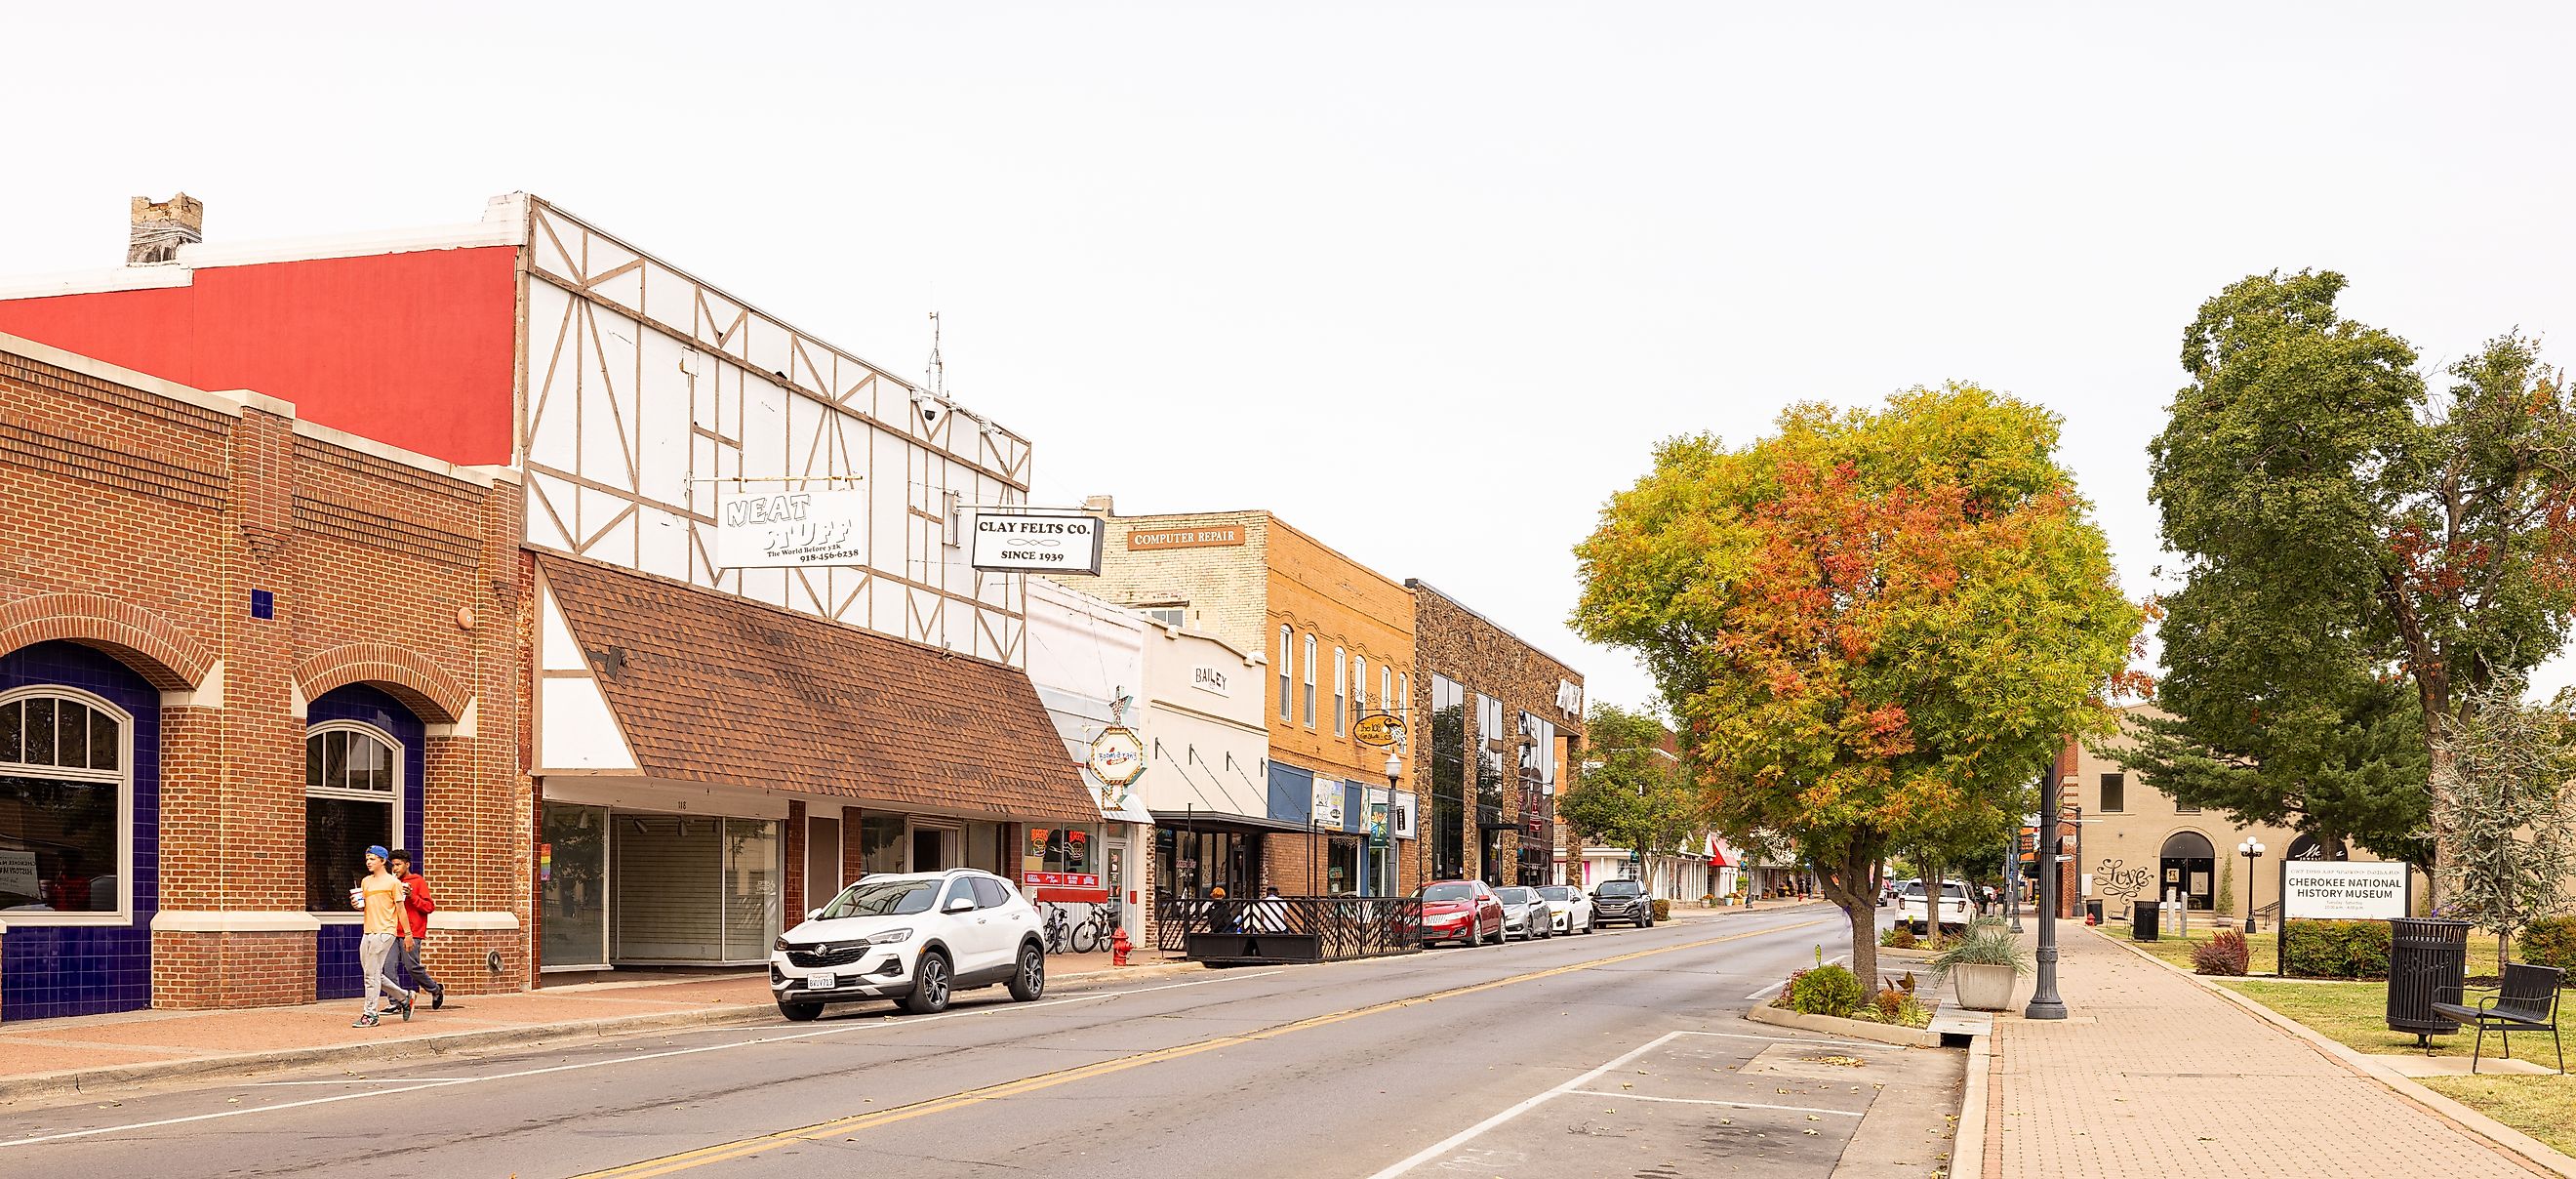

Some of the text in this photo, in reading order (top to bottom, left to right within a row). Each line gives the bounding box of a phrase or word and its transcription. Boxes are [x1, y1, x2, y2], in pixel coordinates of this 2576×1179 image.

[727, 494, 811, 528] NEAT
[979, 521, 1091, 535] CLAY FELTS CO.
[1134, 530, 1235, 546] COMPUTER REPAIR
[782, 547, 803, 555] World
[804, 545, 826, 553] Before
[1001, 550, 1035, 559] SINCE
[1195, 668, 1228, 691] BAILEY
[1068, 831, 1086, 844] BURGERS
[2093, 859, 2154, 898] Love
[2288, 877, 2402, 888] CHEROKEE NATIONAL
[2297, 889, 2393, 899] HISTORY MUSEUM
